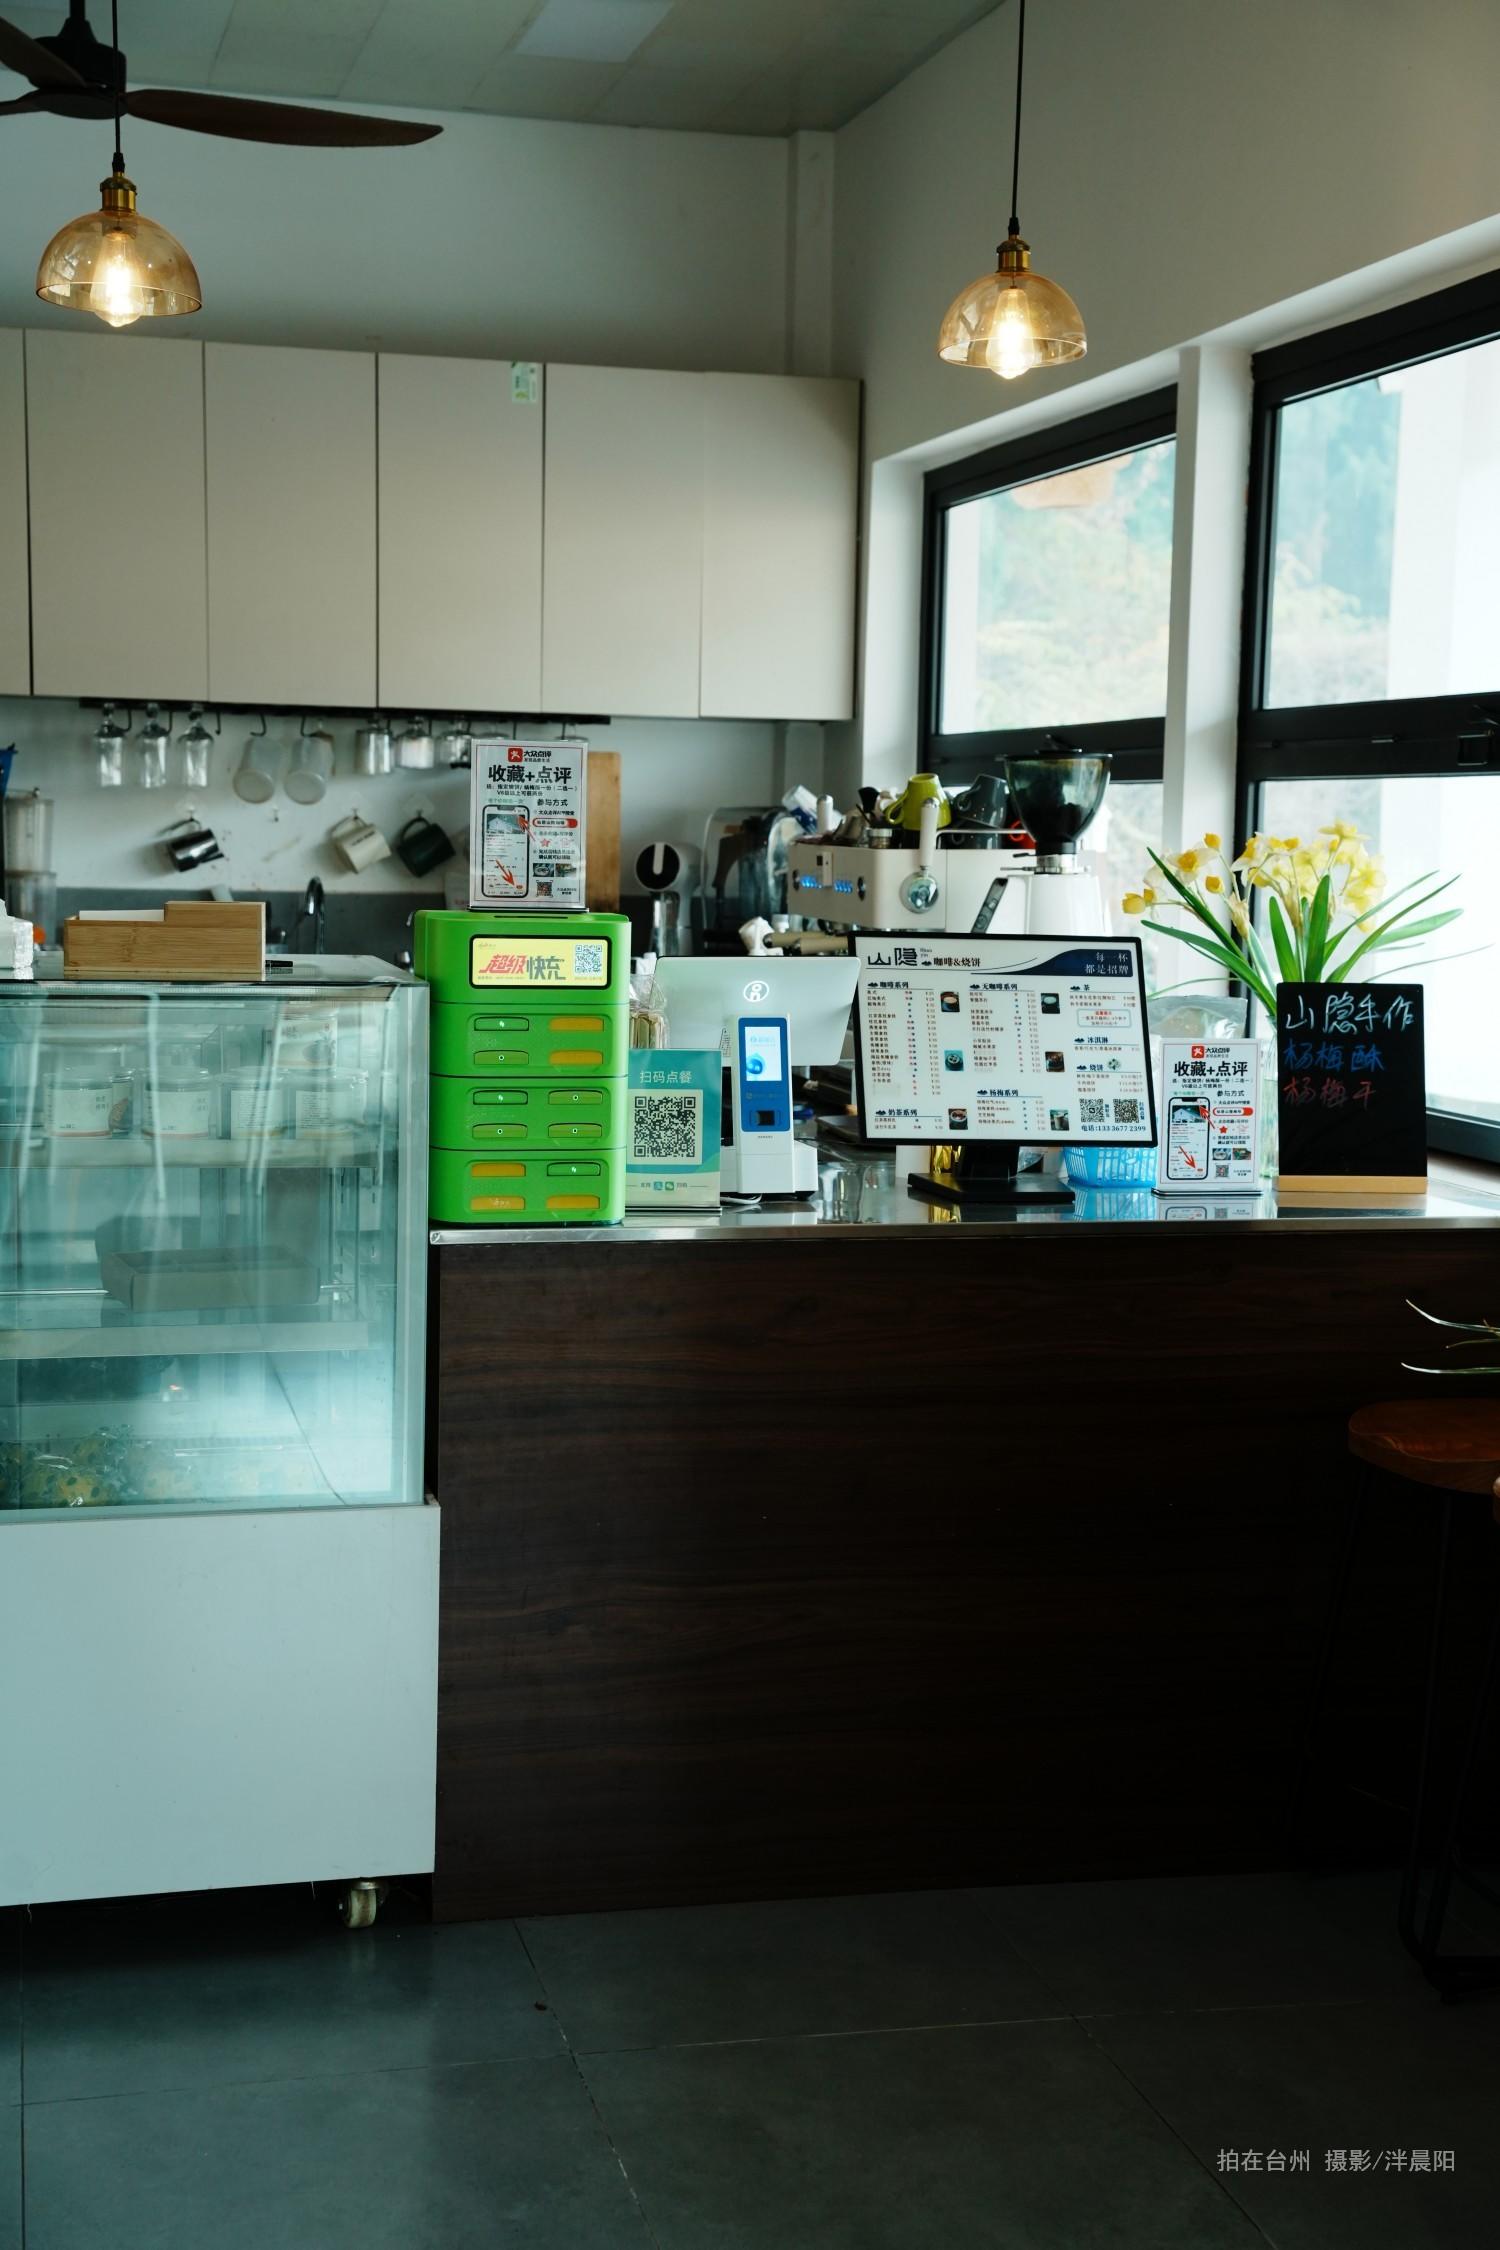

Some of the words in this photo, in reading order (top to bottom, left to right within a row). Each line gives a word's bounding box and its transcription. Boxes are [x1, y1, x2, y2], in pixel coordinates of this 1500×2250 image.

[523, 750, 552, 758] 大众点评
[488, 764, 572, 784] 收藏+点评
[537, 798, 568, 807] 参与方式
[867, 947, 918, 966] 山隐
[478, 953, 566, 980] 超级快充
[934, 957, 981, 967] 咖啡&烧饼
[1085, 964, 1129, 974] 都是招牌
[880, 981, 909, 989] 咖啡系列
[983, 983, 1018, 991] 无咖啡系列
[1285, 991, 1414, 1035] 山隐手作
[1088, 1036, 1108, 1044] 冰淇淋
[1283, 1039, 1385, 1073] 杨梅酥
[1174, 1060, 1248, 1077] 收藏+点评
[639, 1070, 693, 1084] 扫码点餐
[990, 1089, 1019, 1097] 杨梅系列
